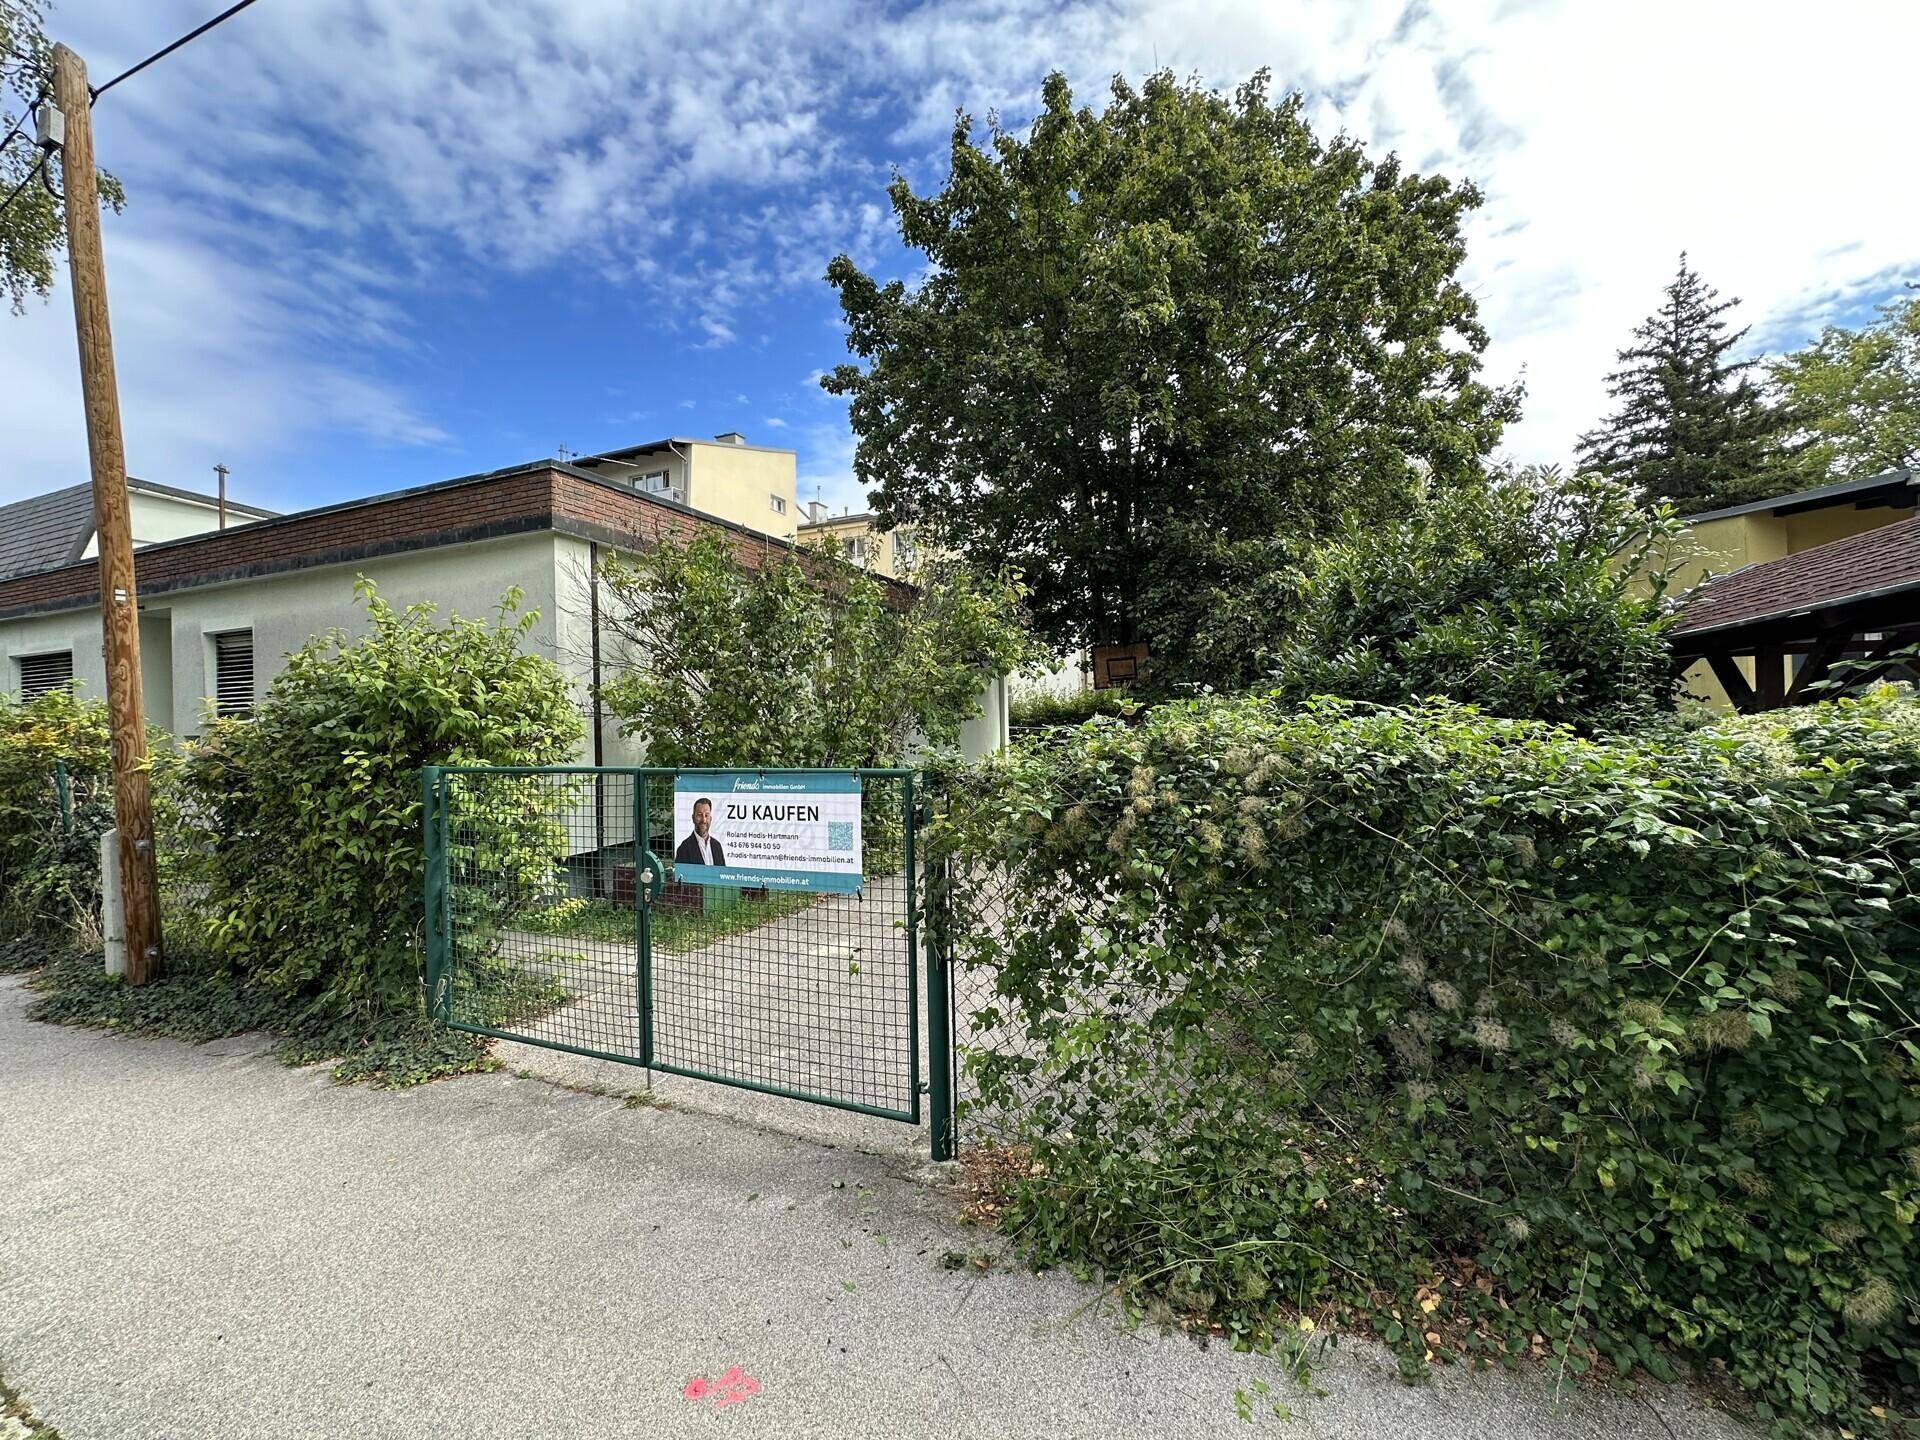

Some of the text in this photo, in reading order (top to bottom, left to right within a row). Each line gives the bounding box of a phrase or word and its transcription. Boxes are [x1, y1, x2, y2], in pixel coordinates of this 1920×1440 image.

[732, 777, 759, 792] friends
[727, 804, 819, 822] ZU KAUFEN
[748, 832, 799, 840] Hodis-Hartmann
[763, 842, 772, 850] 50
[727, 852, 854, 864] r.hodis-hartmann@friends-immobilien.at
[720, 873, 809, 885] www.friends-immobilien.at
